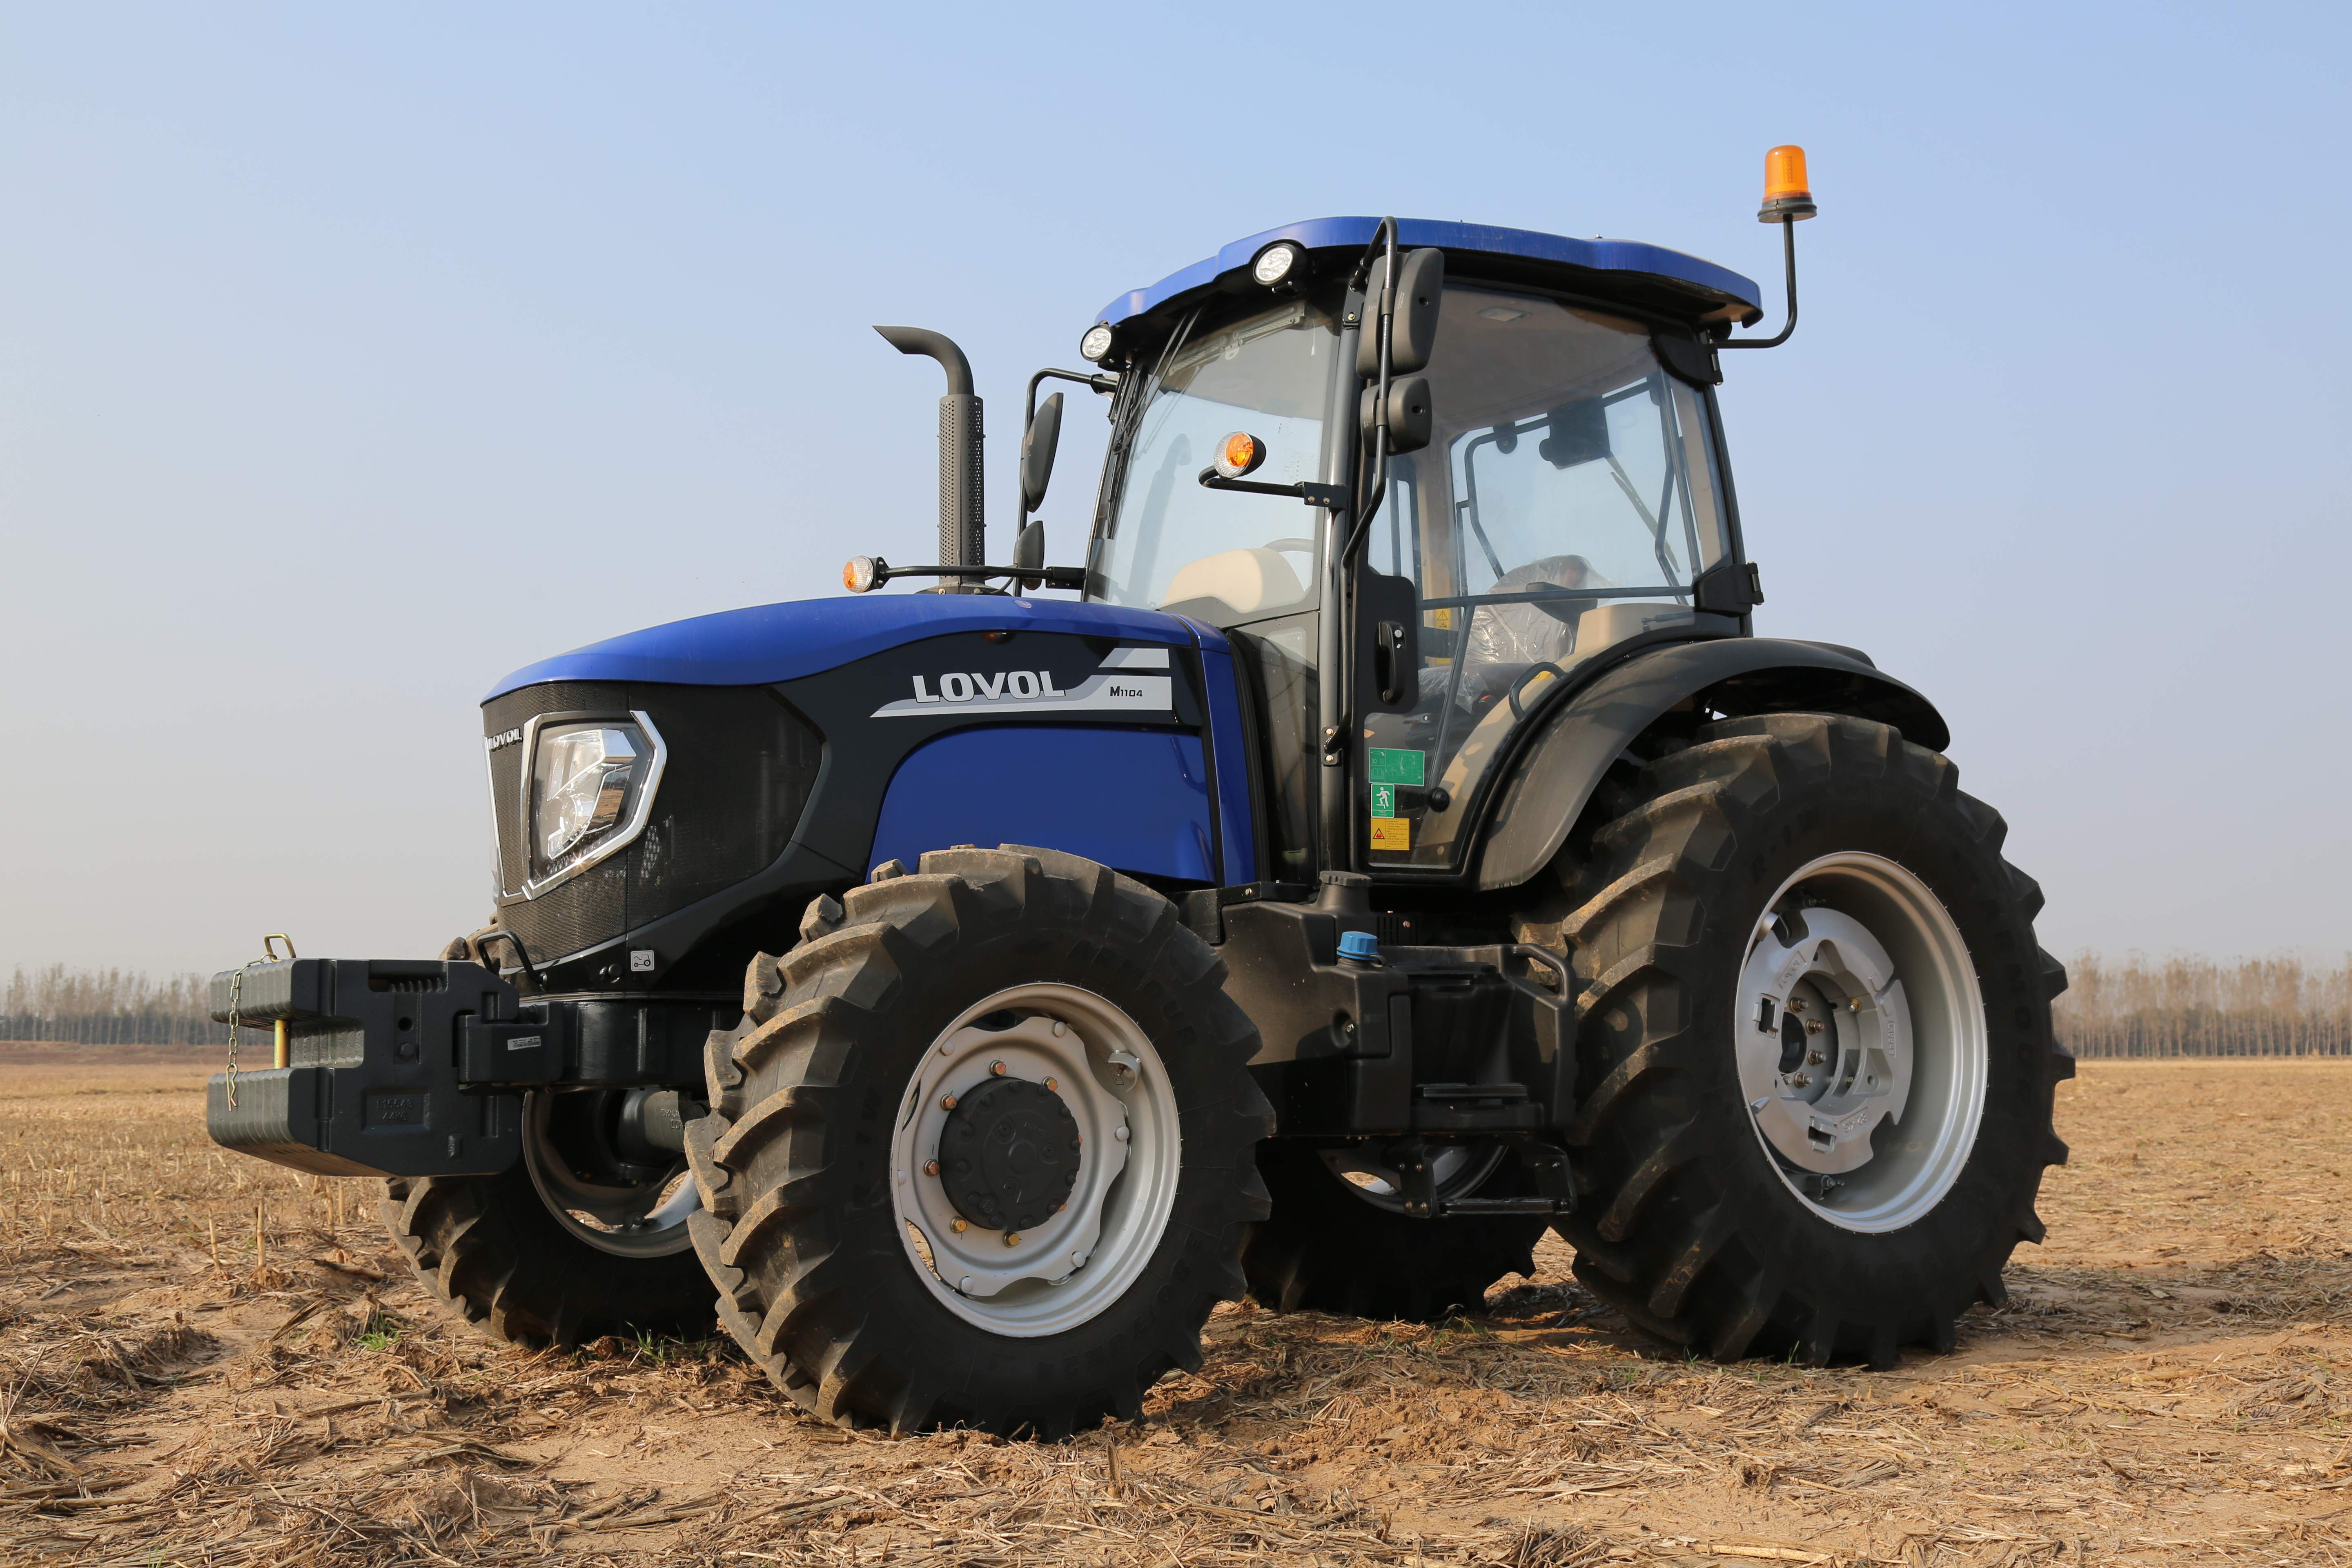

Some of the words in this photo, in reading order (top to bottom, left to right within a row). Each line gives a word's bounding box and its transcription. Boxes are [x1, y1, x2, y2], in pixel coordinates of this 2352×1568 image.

[912, 671, 1065, 703] LOVOL
[1110, 686, 1143, 697] M1104
[488, 728, 522, 749] LOVOL
